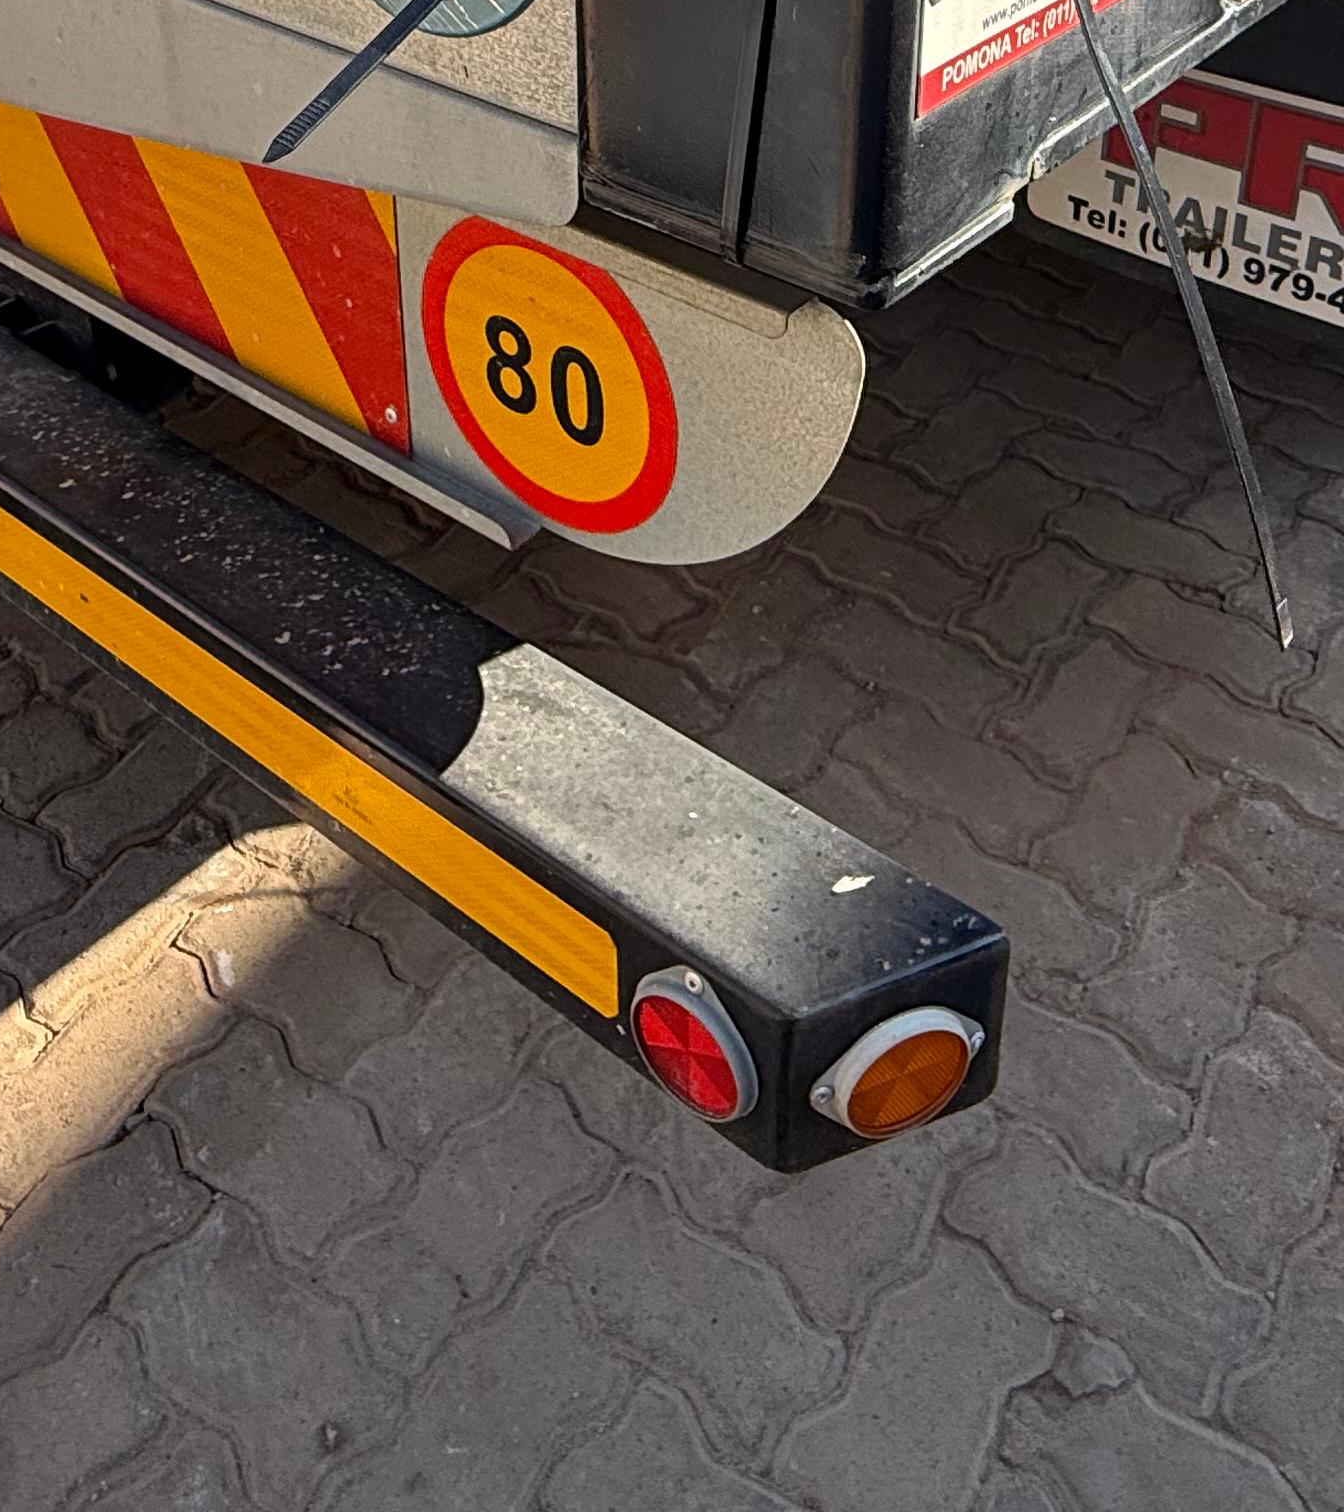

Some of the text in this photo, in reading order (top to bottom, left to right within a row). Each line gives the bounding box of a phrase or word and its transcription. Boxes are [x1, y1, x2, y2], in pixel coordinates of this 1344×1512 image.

[941, 34, 1012, 92] POMONA
[1015, 18, 1040, 49] Tel:
[1068, 195, 1128, 239] Tel:
[1139, 221, 1230, 279] (01)
[485, 315, 605, 447] 80
